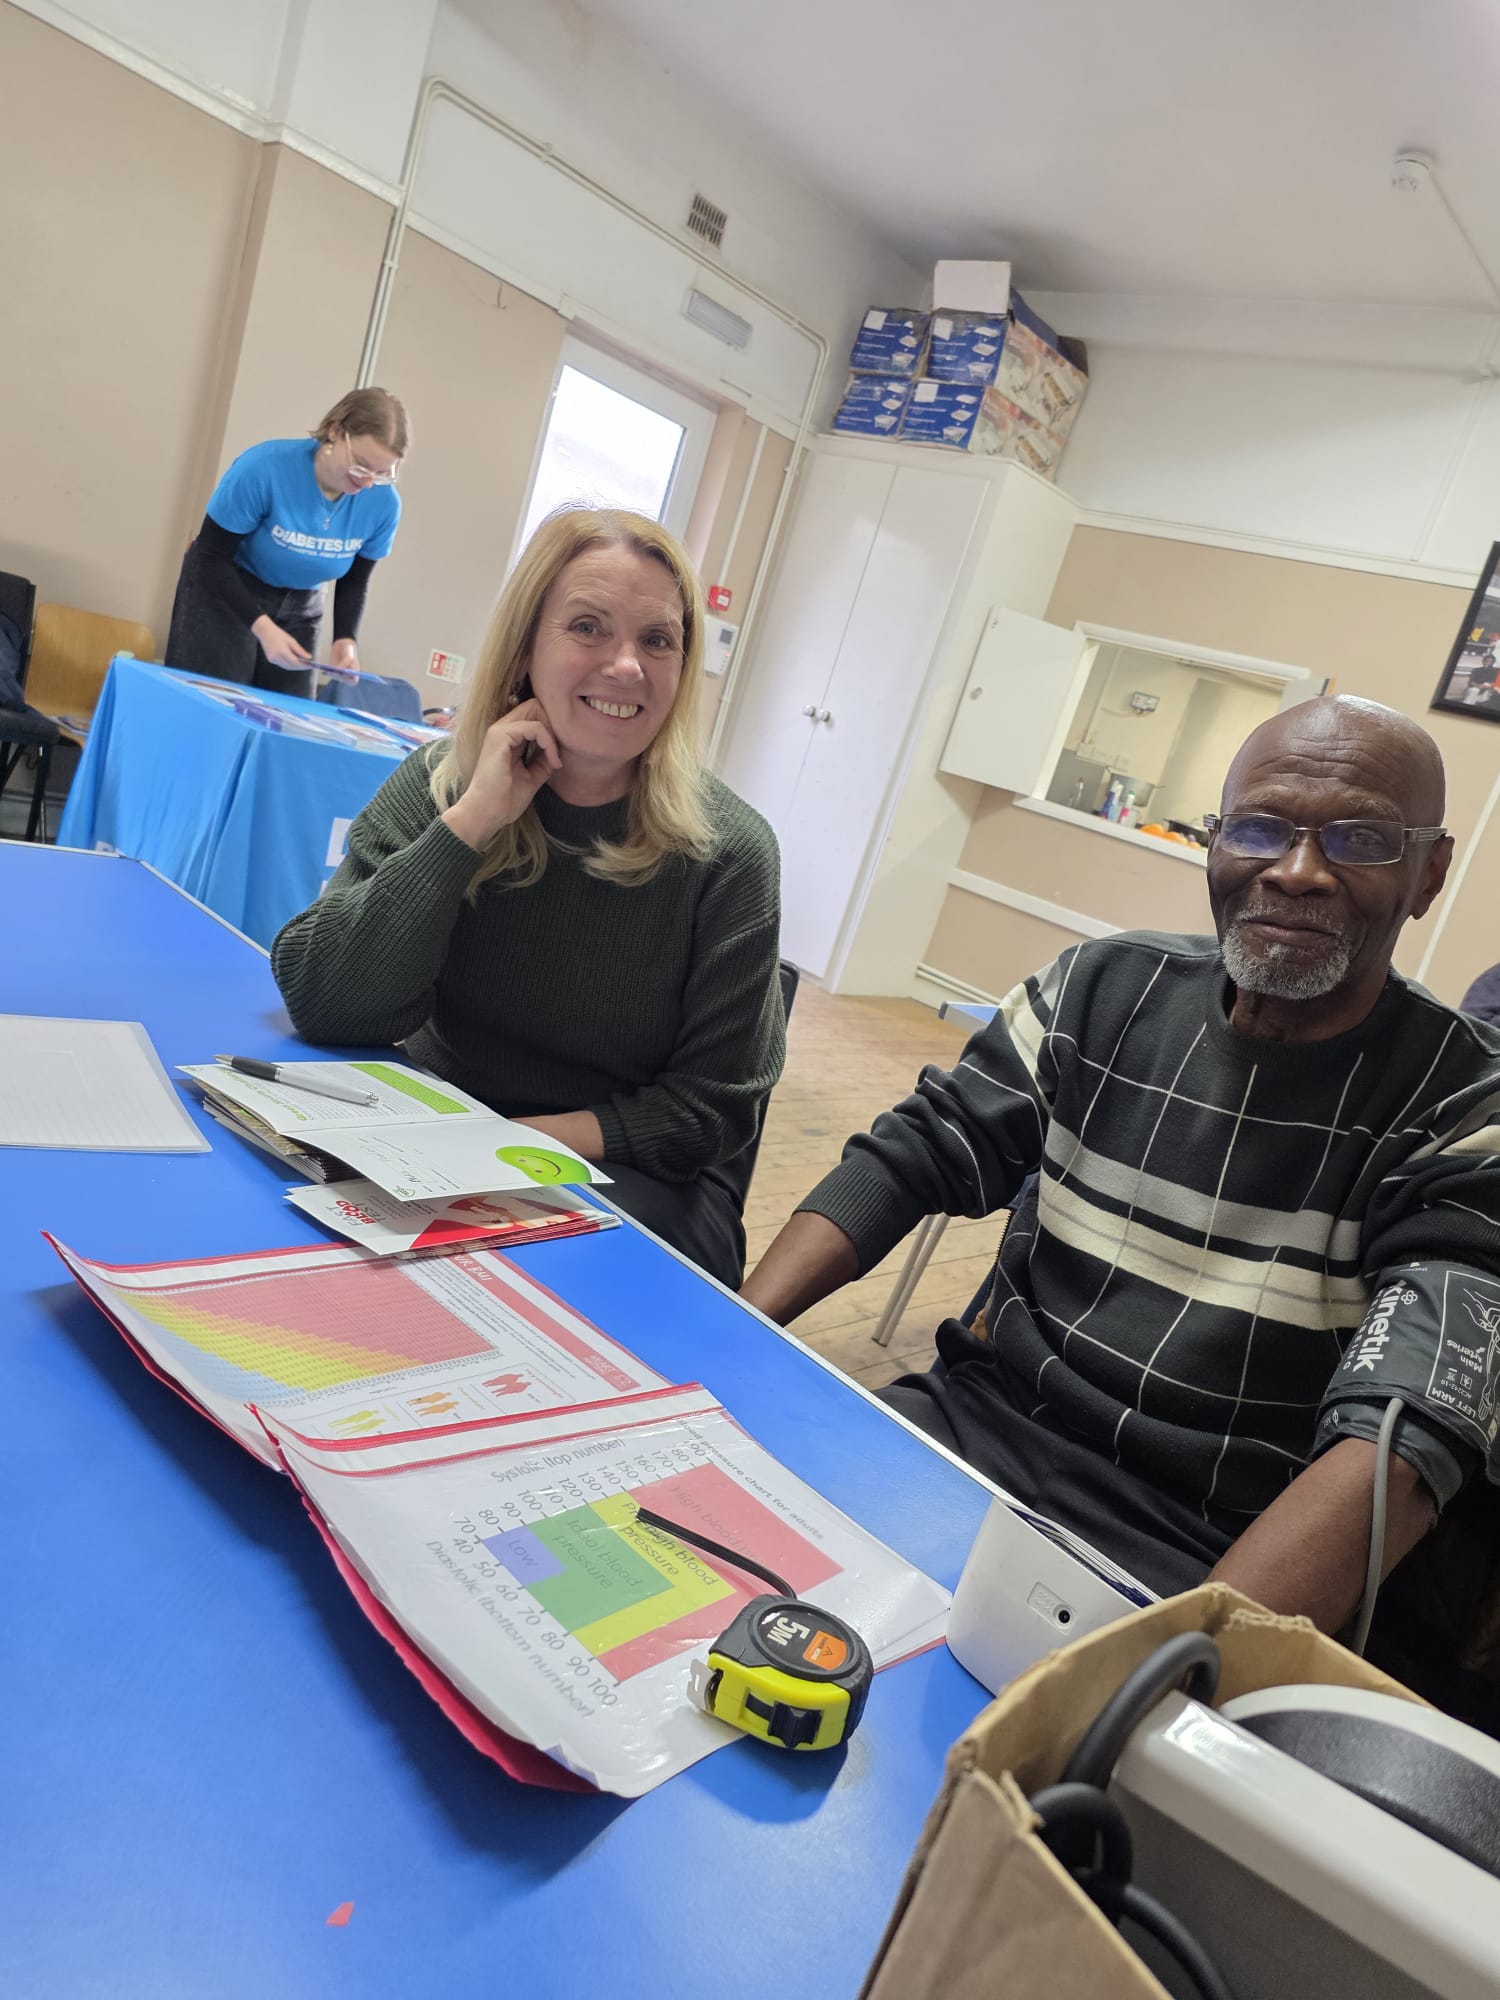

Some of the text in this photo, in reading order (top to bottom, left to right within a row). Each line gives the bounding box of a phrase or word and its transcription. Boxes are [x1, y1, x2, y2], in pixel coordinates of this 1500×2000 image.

[271, 524, 344, 552] DIABETES
[325, 1205, 362, 1226] FAST
[335, 1200, 377, 1225] BLOOD
[467, 1265, 493, 1282] BMI
[1460, 1354, 1483, 1374] Main
[1431, 1386, 1477, 1418] LEFT ARM
[541, 1452, 573, 1469] (top
[572, 1437, 626, 1460] number)
[633, 1454, 657, 1474] 160
[650, 1449, 675, 1469] 170
[577, 1471, 602, 1492] 130
[596, 1466, 622, 1486] 140
[615, 1460, 639, 1480] 150
[517, 1488, 543, 1511] 100
[557, 1476, 584, 1498] 120
[699, 1438, 745, 1475] pressure
[744, 1474, 773, 1499] chart
[772, 1496, 789, 1512] for
[789, 1511, 825, 1541] adults
[478, 1508, 500, 1526] 80
[500, 1501, 522, 1519] 90
[669, 1486, 744, 1547] High blood
[453, 1515, 477, 1534] 70
[507, 1539, 540, 1568] Low
[552, 1534, 614, 1590] pressure
[567, 1518, 641, 1587] Ideal blood
[618, 1525, 680, 1577] pressure
[674, 1547, 719, 1587] blood
[425, 1540, 596, 1718] Diastolic (bottom number)
[453, 1537, 619, 1707] 40 50 60 70 80 90 100
[766, 1616, 811, 1647] 5M
